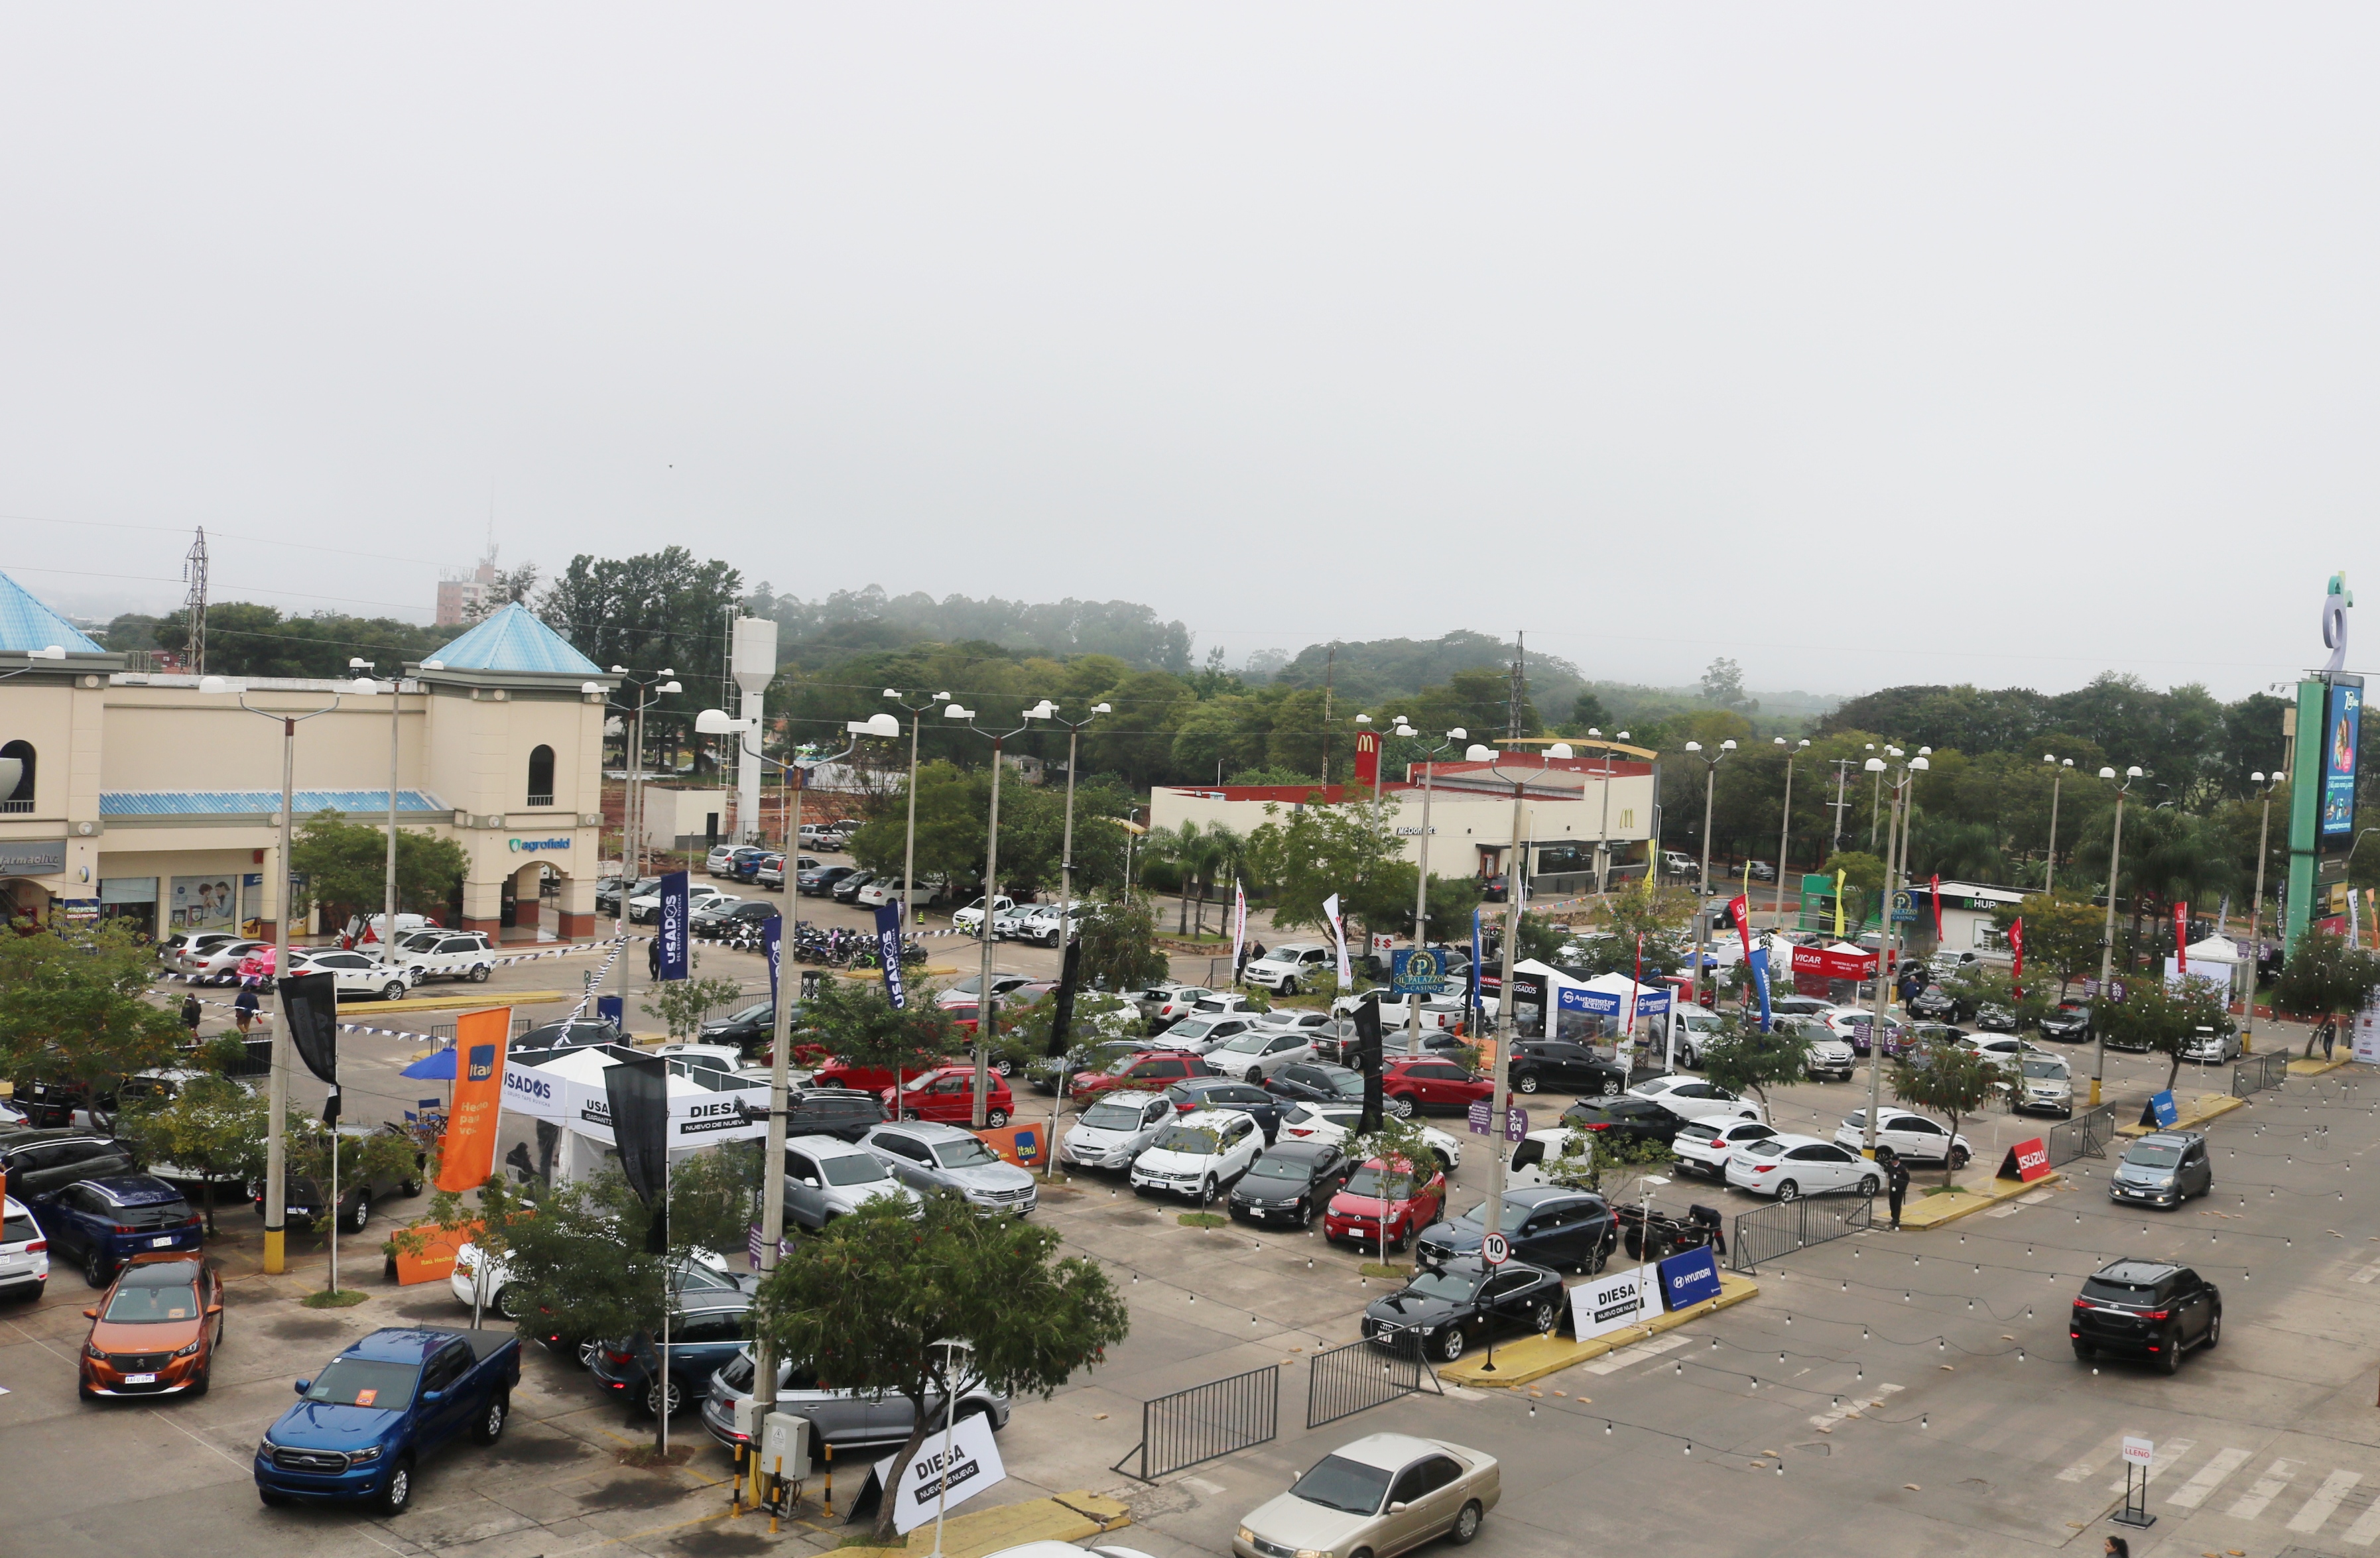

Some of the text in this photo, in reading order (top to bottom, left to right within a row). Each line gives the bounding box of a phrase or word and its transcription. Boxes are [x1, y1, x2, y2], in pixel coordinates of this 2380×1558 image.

[1397, 827, 1437, 835] McDond's
[522, 838, 570, 852] agrofield
[664, 895, 678, 964] USADOS
[1794, 953, 1821, 964] VICAR
[883, 930, 905, 1008] USADOS
[1513, 985, 1537, 994] USADOS
[1574, 995, 1617, 1006] Automotor
[1583, 1002, 1610, 1011] USADOS
[470, 1062, 492, 1077] Itaú
[587, 1099, 609, 1114] USA
[586, 1113, 613, 1125] GARANTI
[1510, 1123, 1523, 1134] 04
[1017, 1144, 1036, 1156] Itaú
[2018, 1150, 2046, 1169] ISUZU
[1488, 1238, 1503, 1254] 10
[1684, 1267, 1712, 1284] HYUNDAI
[1598, 1284, 1636, 1305] DIESA
[1597, 1309, 1616, 1319] NUEVO
[1623, 1301, 1638, 1311] NUEV
[2125, 1448, 2150, 1459] LLENO
[915, 1444, 966, 1480] DIESA
[952, 1465, 974, 1482] NUEVO
